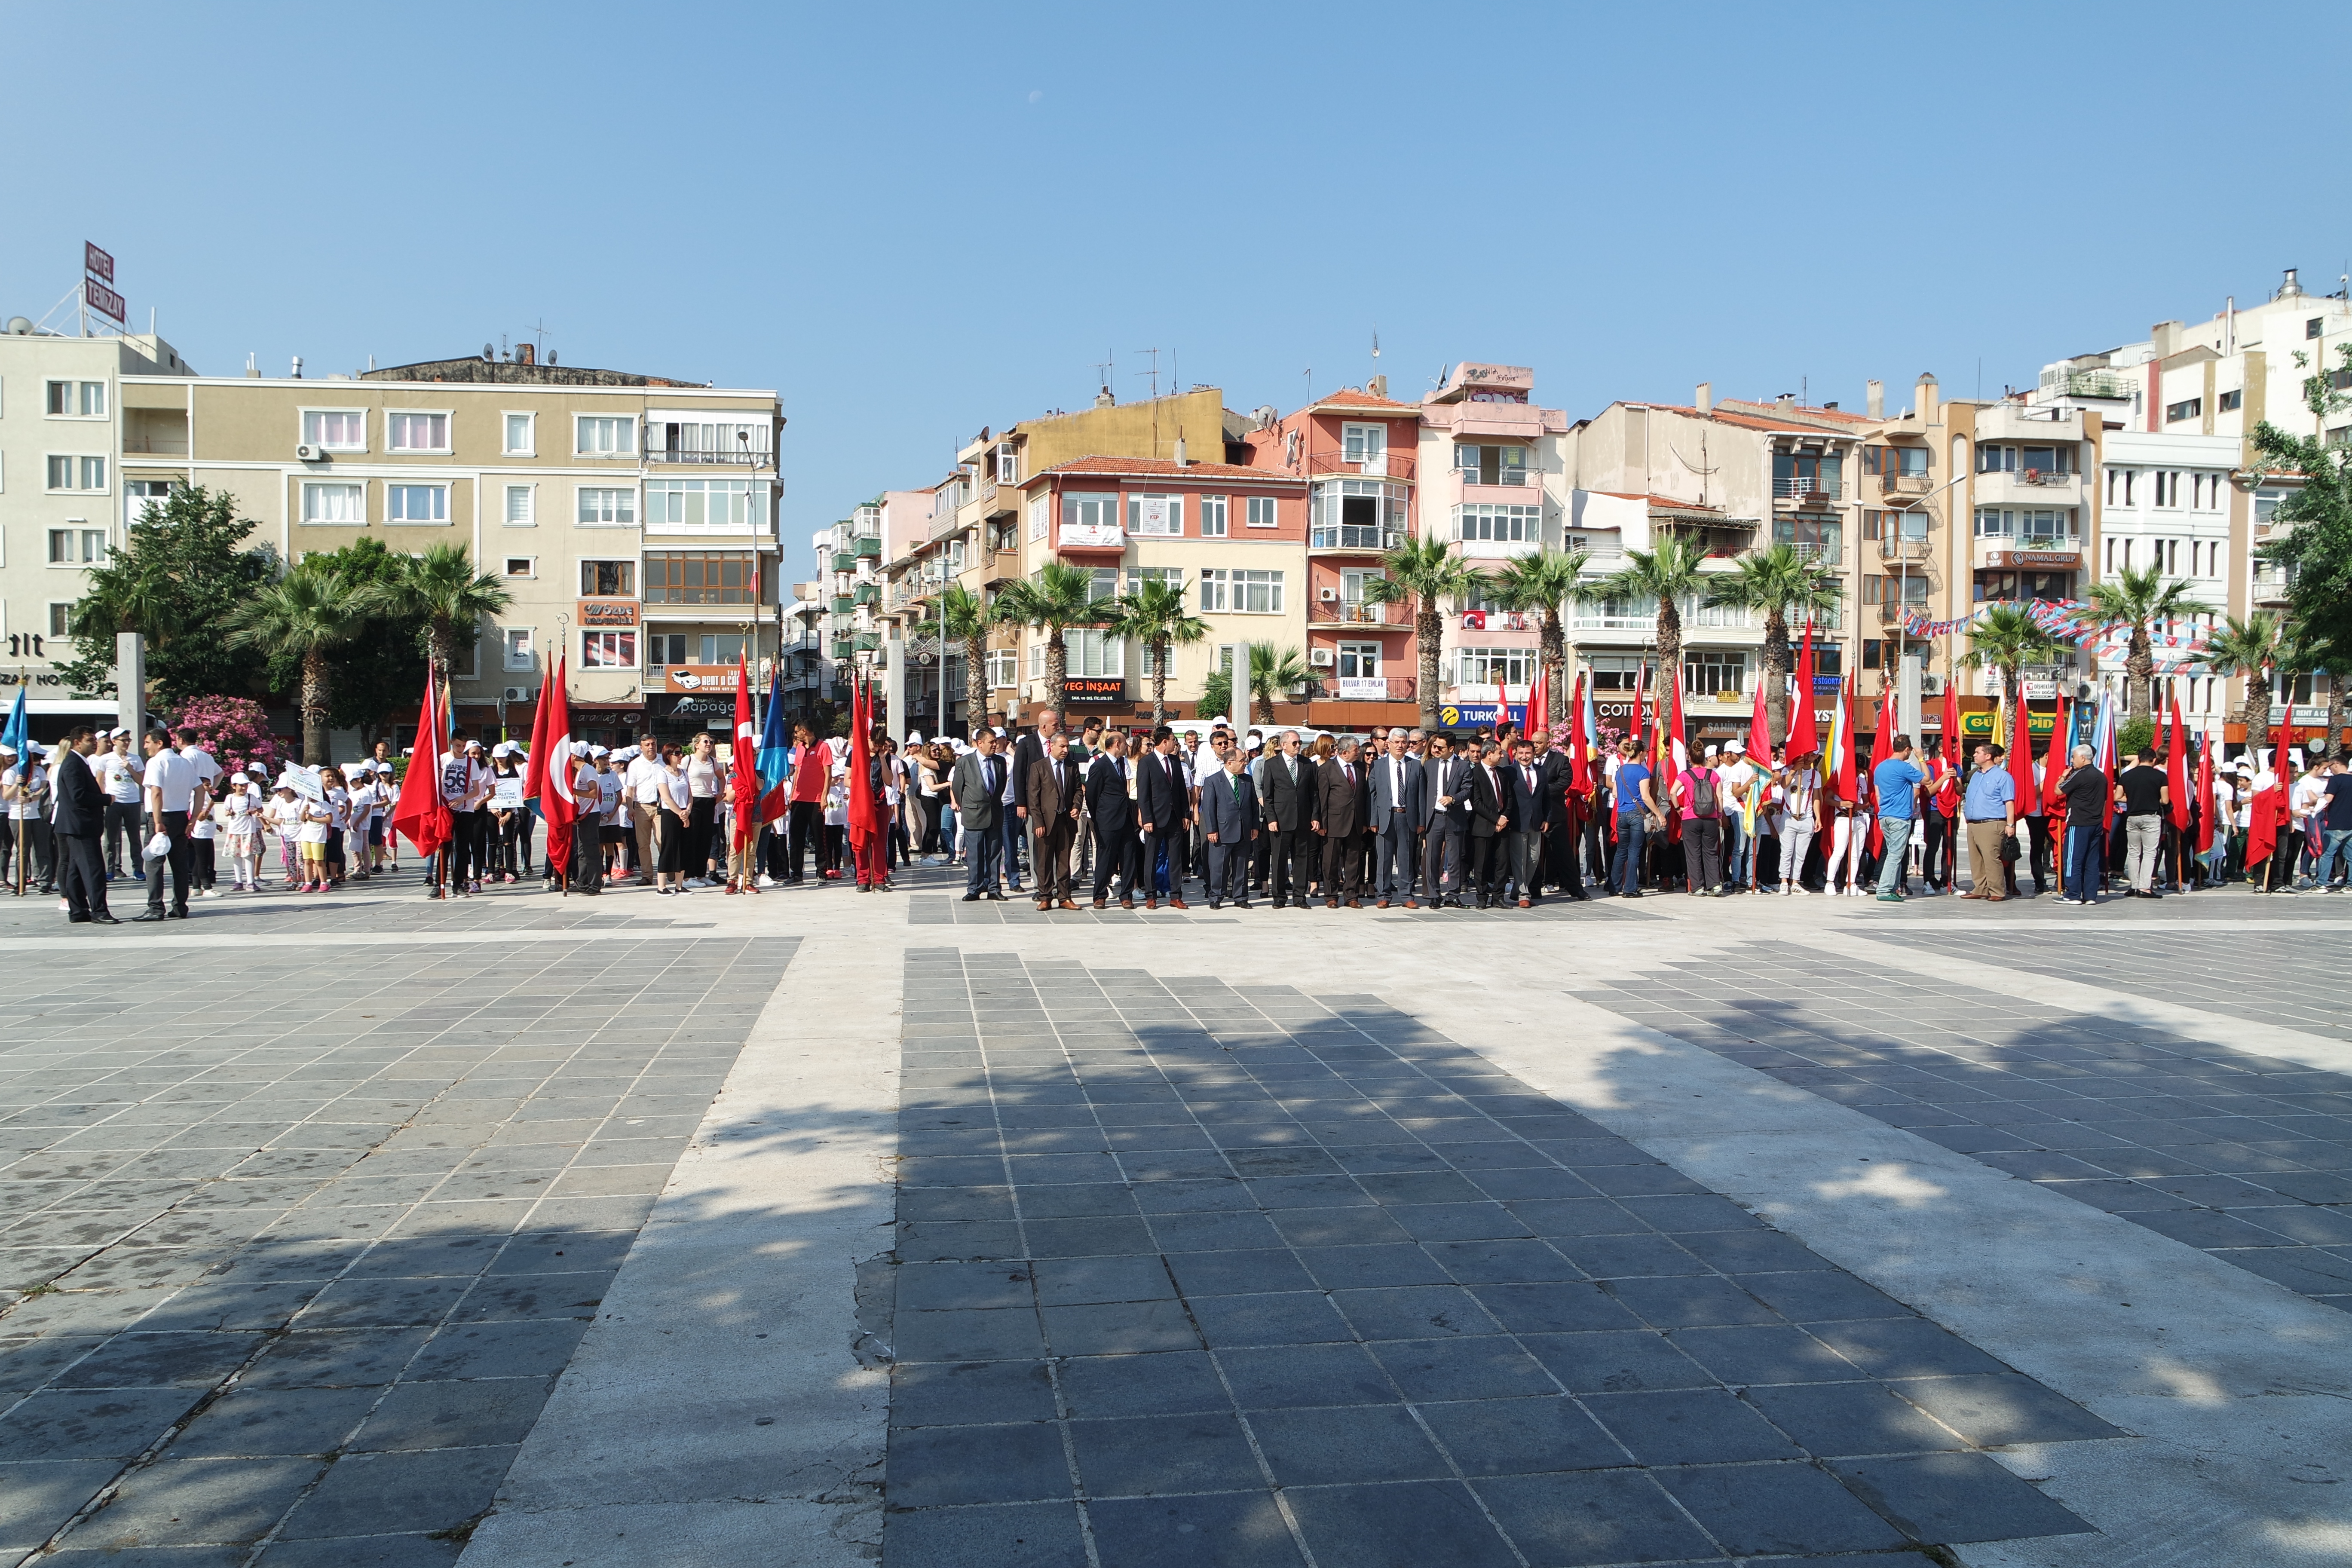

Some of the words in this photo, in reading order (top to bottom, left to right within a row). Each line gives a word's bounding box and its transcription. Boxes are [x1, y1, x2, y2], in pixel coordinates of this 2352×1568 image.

[89, 244, 112, 279] HOTEL
[602, 603, 633, 615] ÖZDE
[36, 674, 61, 686] HO
[1086, 680, 1121, 693] İNŞAAT
[681, 700, 735, 714] papağa
[1707, 720, 1737, 735] ŞAHİN
[1739, 723, 1751, 733] SA
[1971, 717, 1994, 727] GÜ
[2027, 717, 2054, 729] PİD
[2078, 720, 2092, 733] İYİ
[444, 770, 466, 788] 56
